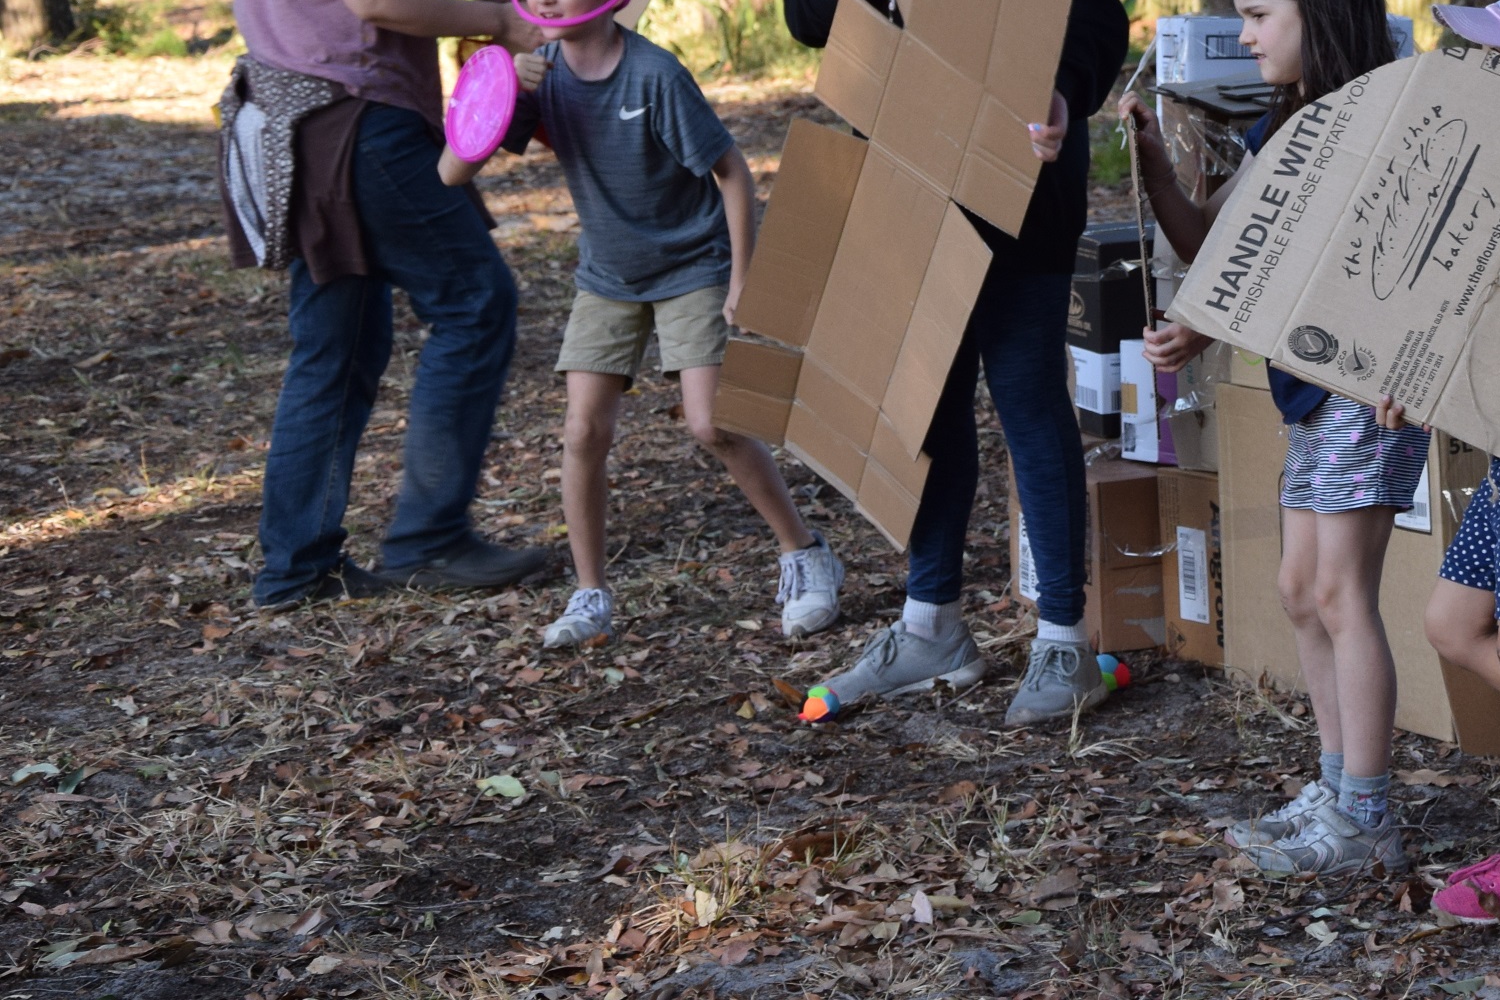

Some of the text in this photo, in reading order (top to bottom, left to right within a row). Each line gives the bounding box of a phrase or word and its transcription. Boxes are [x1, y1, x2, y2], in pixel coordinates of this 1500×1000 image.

[1205, 101, 1333, 313] HANDLE WITH
[1228, 69, 1373, 333] PERISHABLE PLEASE ROTATE YOU
[1342, 105, 1442, 279] the flour shop
[1432, 187, 1496, 272] bakery
[1356, 346, 1377, 382] FOOD SAFETY
[1379, 386, 1387, 394] PO
[1383, 375, 1392, 386] BOX
[1395, 343, 1408, 361] DARRA
[1403, 359, 1421, 387] BOUNDARY
[1417, 344, 1429, 359] ROAD
[1407, 331, 1425, 359] AUSTRALIA
